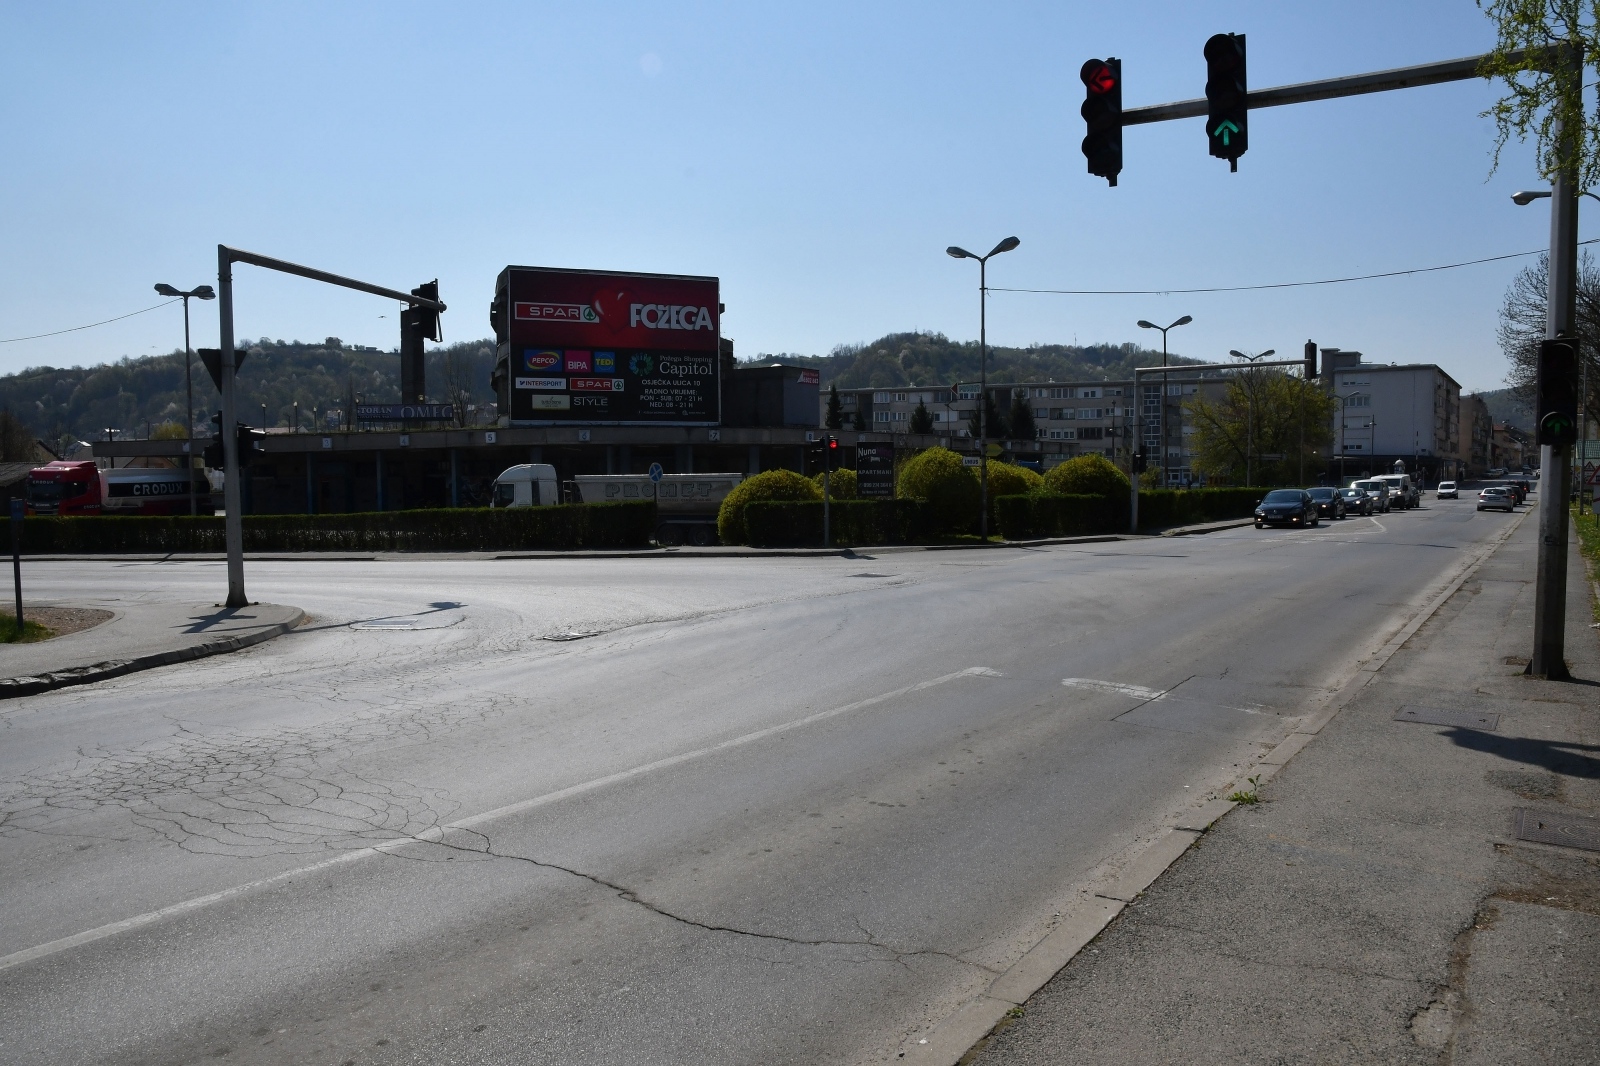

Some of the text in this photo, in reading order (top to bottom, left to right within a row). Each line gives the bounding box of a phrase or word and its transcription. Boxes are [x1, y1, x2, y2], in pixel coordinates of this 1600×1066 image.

[529, 306, 580, 318] SPAR
[630, 303, 714, 331] POŽEGA
[567, 361, 588, 370] BIPA
[683, 355, 713, 364] Shopping
[659, 361, 713, 378] Capitol
[577, 380, 611, 388] SPAR
[573, 396, 609, 406] STYLE
[133, 483, 184, 496] CRODUX
[605, 483, 713, 498] PROMET
